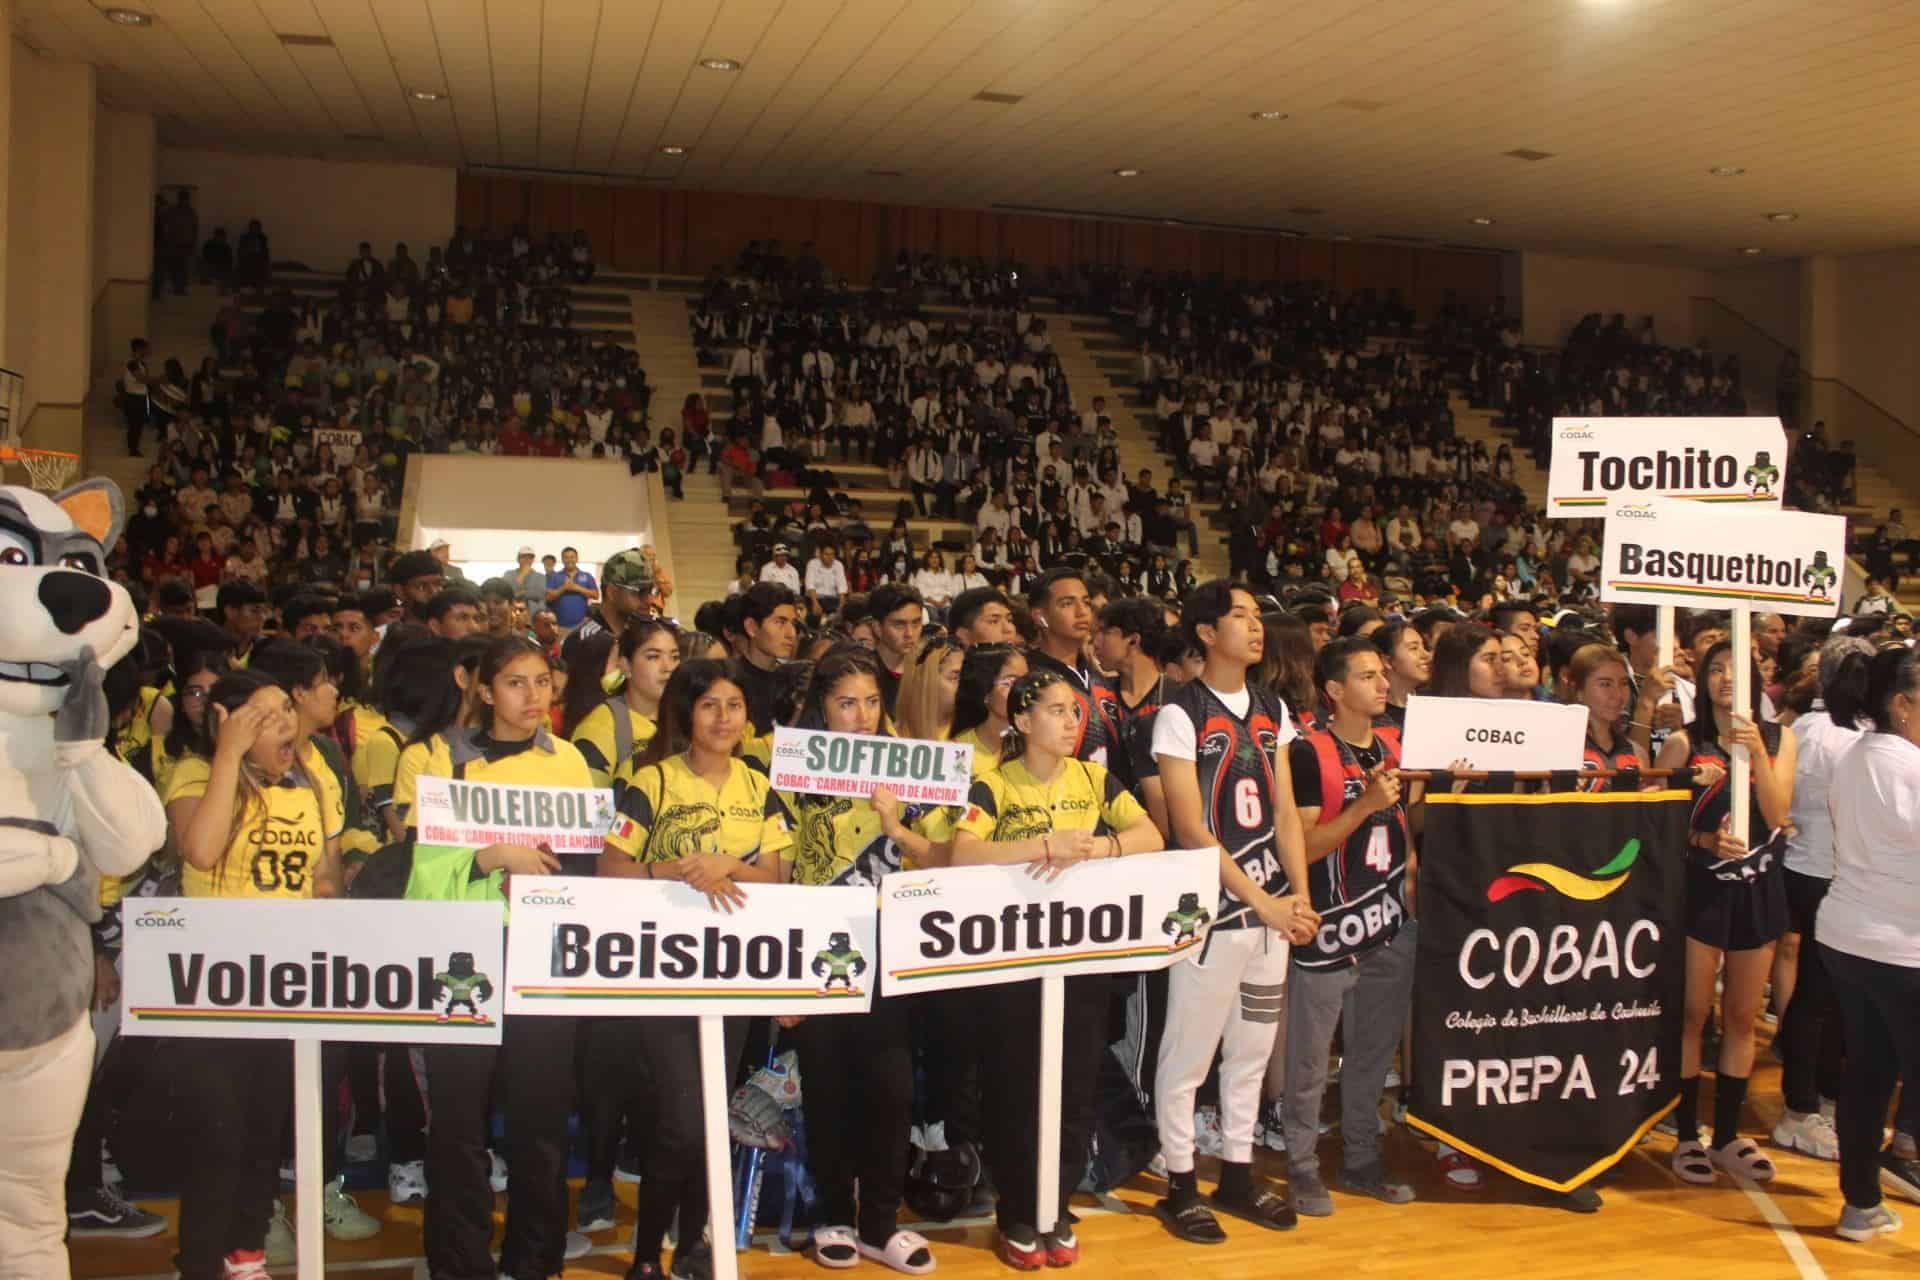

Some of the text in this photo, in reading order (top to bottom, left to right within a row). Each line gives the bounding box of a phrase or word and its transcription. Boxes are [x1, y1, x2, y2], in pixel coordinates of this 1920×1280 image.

[1578, 448, 1738, 491] Tochito
[1619, 543, 1801, 588] Basquetbol
[806, 735, 946, 782] SOFTBOL
[1465, 728, 1526, 745] COBAC
[449, 784, 592, 829] VOLEIBOL
[776, 773, 810, 789] COBAC
[907, 786, 921, 798] DE
[1234, 778, 1263, 829] 6
[248, 829, 317, 846] COBAC
[1365, 824, 1392, 873] 4
[135, 917, 185, 928] COBAC
[521, 895, 576, 906] COBAC
[920, 894, 1144, 959] Softbol
[551, 921, 804, 979] Beisbol
[1459, 919, 1660, 989] COBAC
[168, 951, 435, 1010] Voleibol
[1445, 1009, 1497, 1035] Colegio
[1501, 1008, 1518, 1028] de
[1589, 1002, 1607, 1021] de
[1441, 1046, 1661, 1107] PREPA 24
